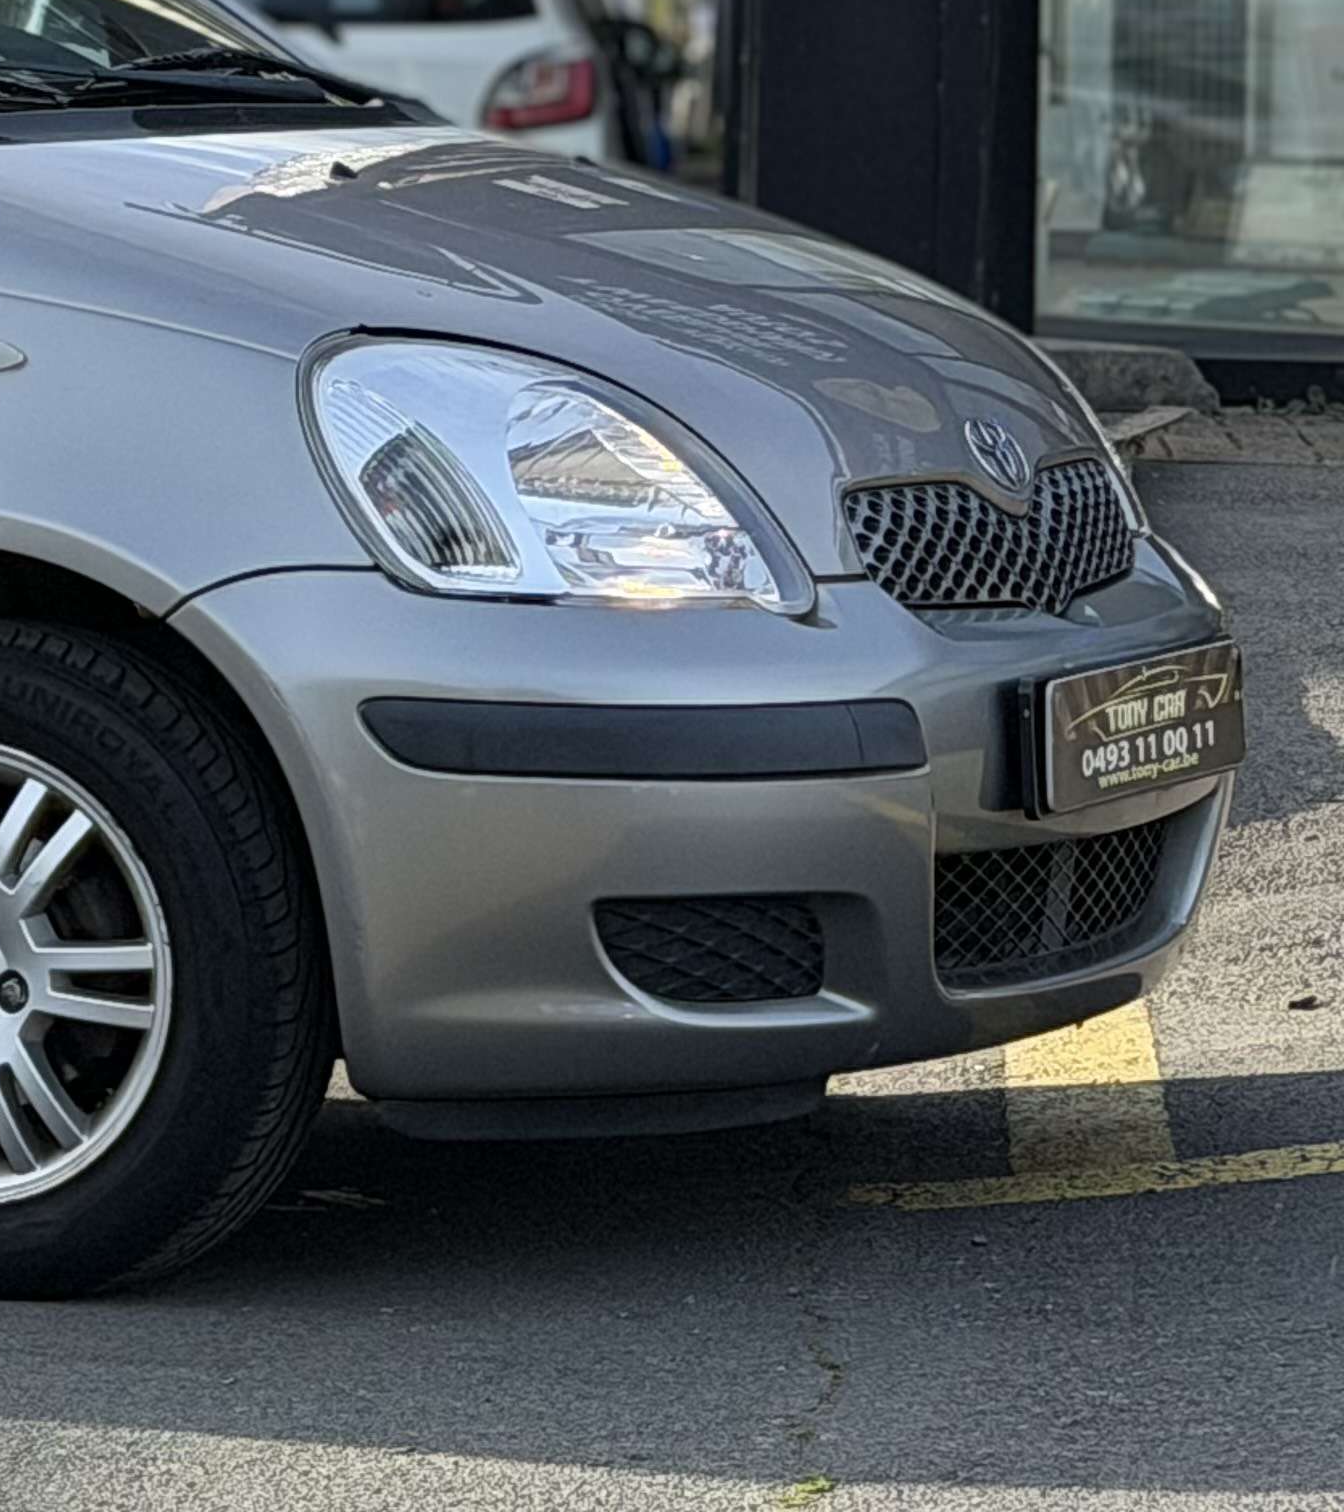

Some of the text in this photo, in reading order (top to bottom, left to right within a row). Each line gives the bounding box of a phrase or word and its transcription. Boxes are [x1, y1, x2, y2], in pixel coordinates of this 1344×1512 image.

[1105, 689, 1188, 733] TONY CAR
[1082, 720, 1215, 777] 0493 11 00 11
[1098, 752, 1200, 789] www.tony-car.be
